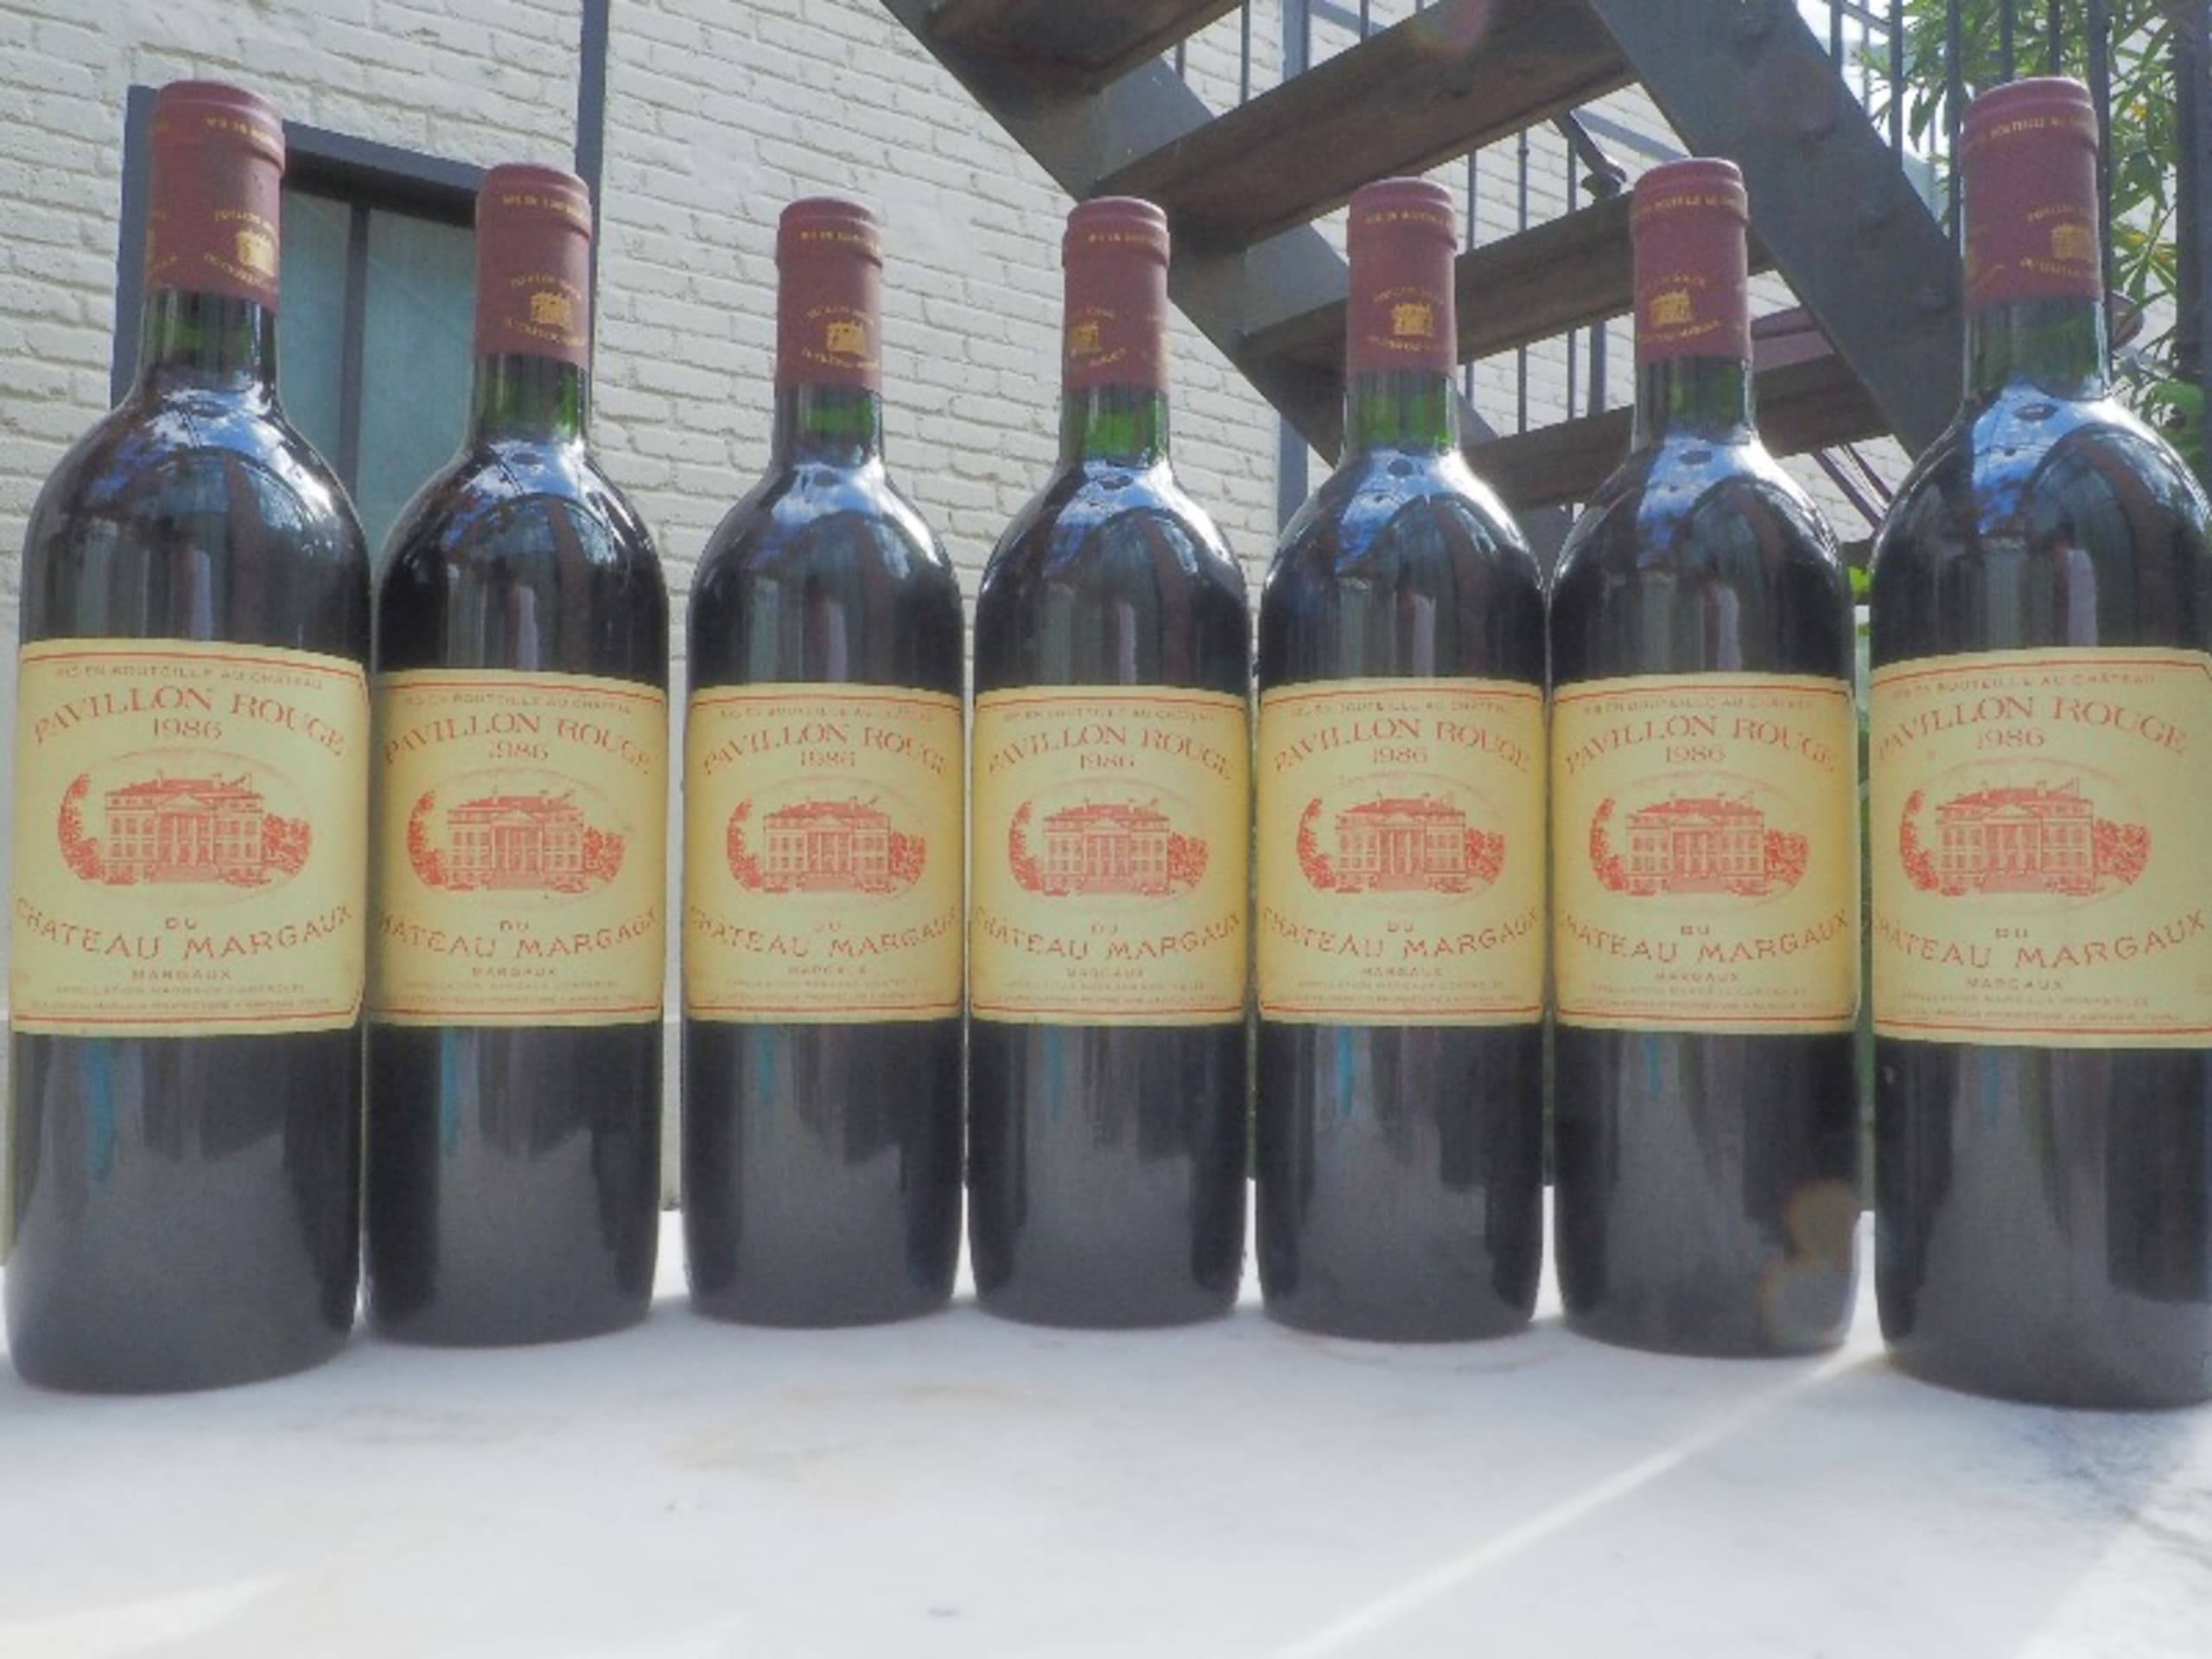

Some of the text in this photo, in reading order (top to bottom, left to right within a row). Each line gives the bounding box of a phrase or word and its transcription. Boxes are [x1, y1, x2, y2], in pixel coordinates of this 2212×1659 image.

[33, 684, 345, 757] PAVILLON ROUGE
[152, 718, 223, 742] 1986
[385, 713, 652, 775] PAVILLON ROUGE
[703, 722, 850, 775] PAVILLON
[1274, 718, 1531, 774] PAVILLON ROUGE
[1565, 715, 1835, 776] PAVILLON ROUGE
[1878, 696, 2189, 761] PAVILLON ROUGE
[1975, 728, 2046, 751] 1986
[988, 724, 1233, 780] PAVILLON ROUGE
[1371, 746, 1430, 765] 1986
[1665, 745, 1726, 765] 1986
[182, 905, 353, 962] MARGAUX
[515, 907, 658, 958] MARGAUX
[1106, 912, 1241, 961] MARGAUX
[1402, 906, 1539, 960] MARGAUX
[1697, 908, 1849, 965] MARGAUX
[2014, 908, 2207, 969] MARGAUX
